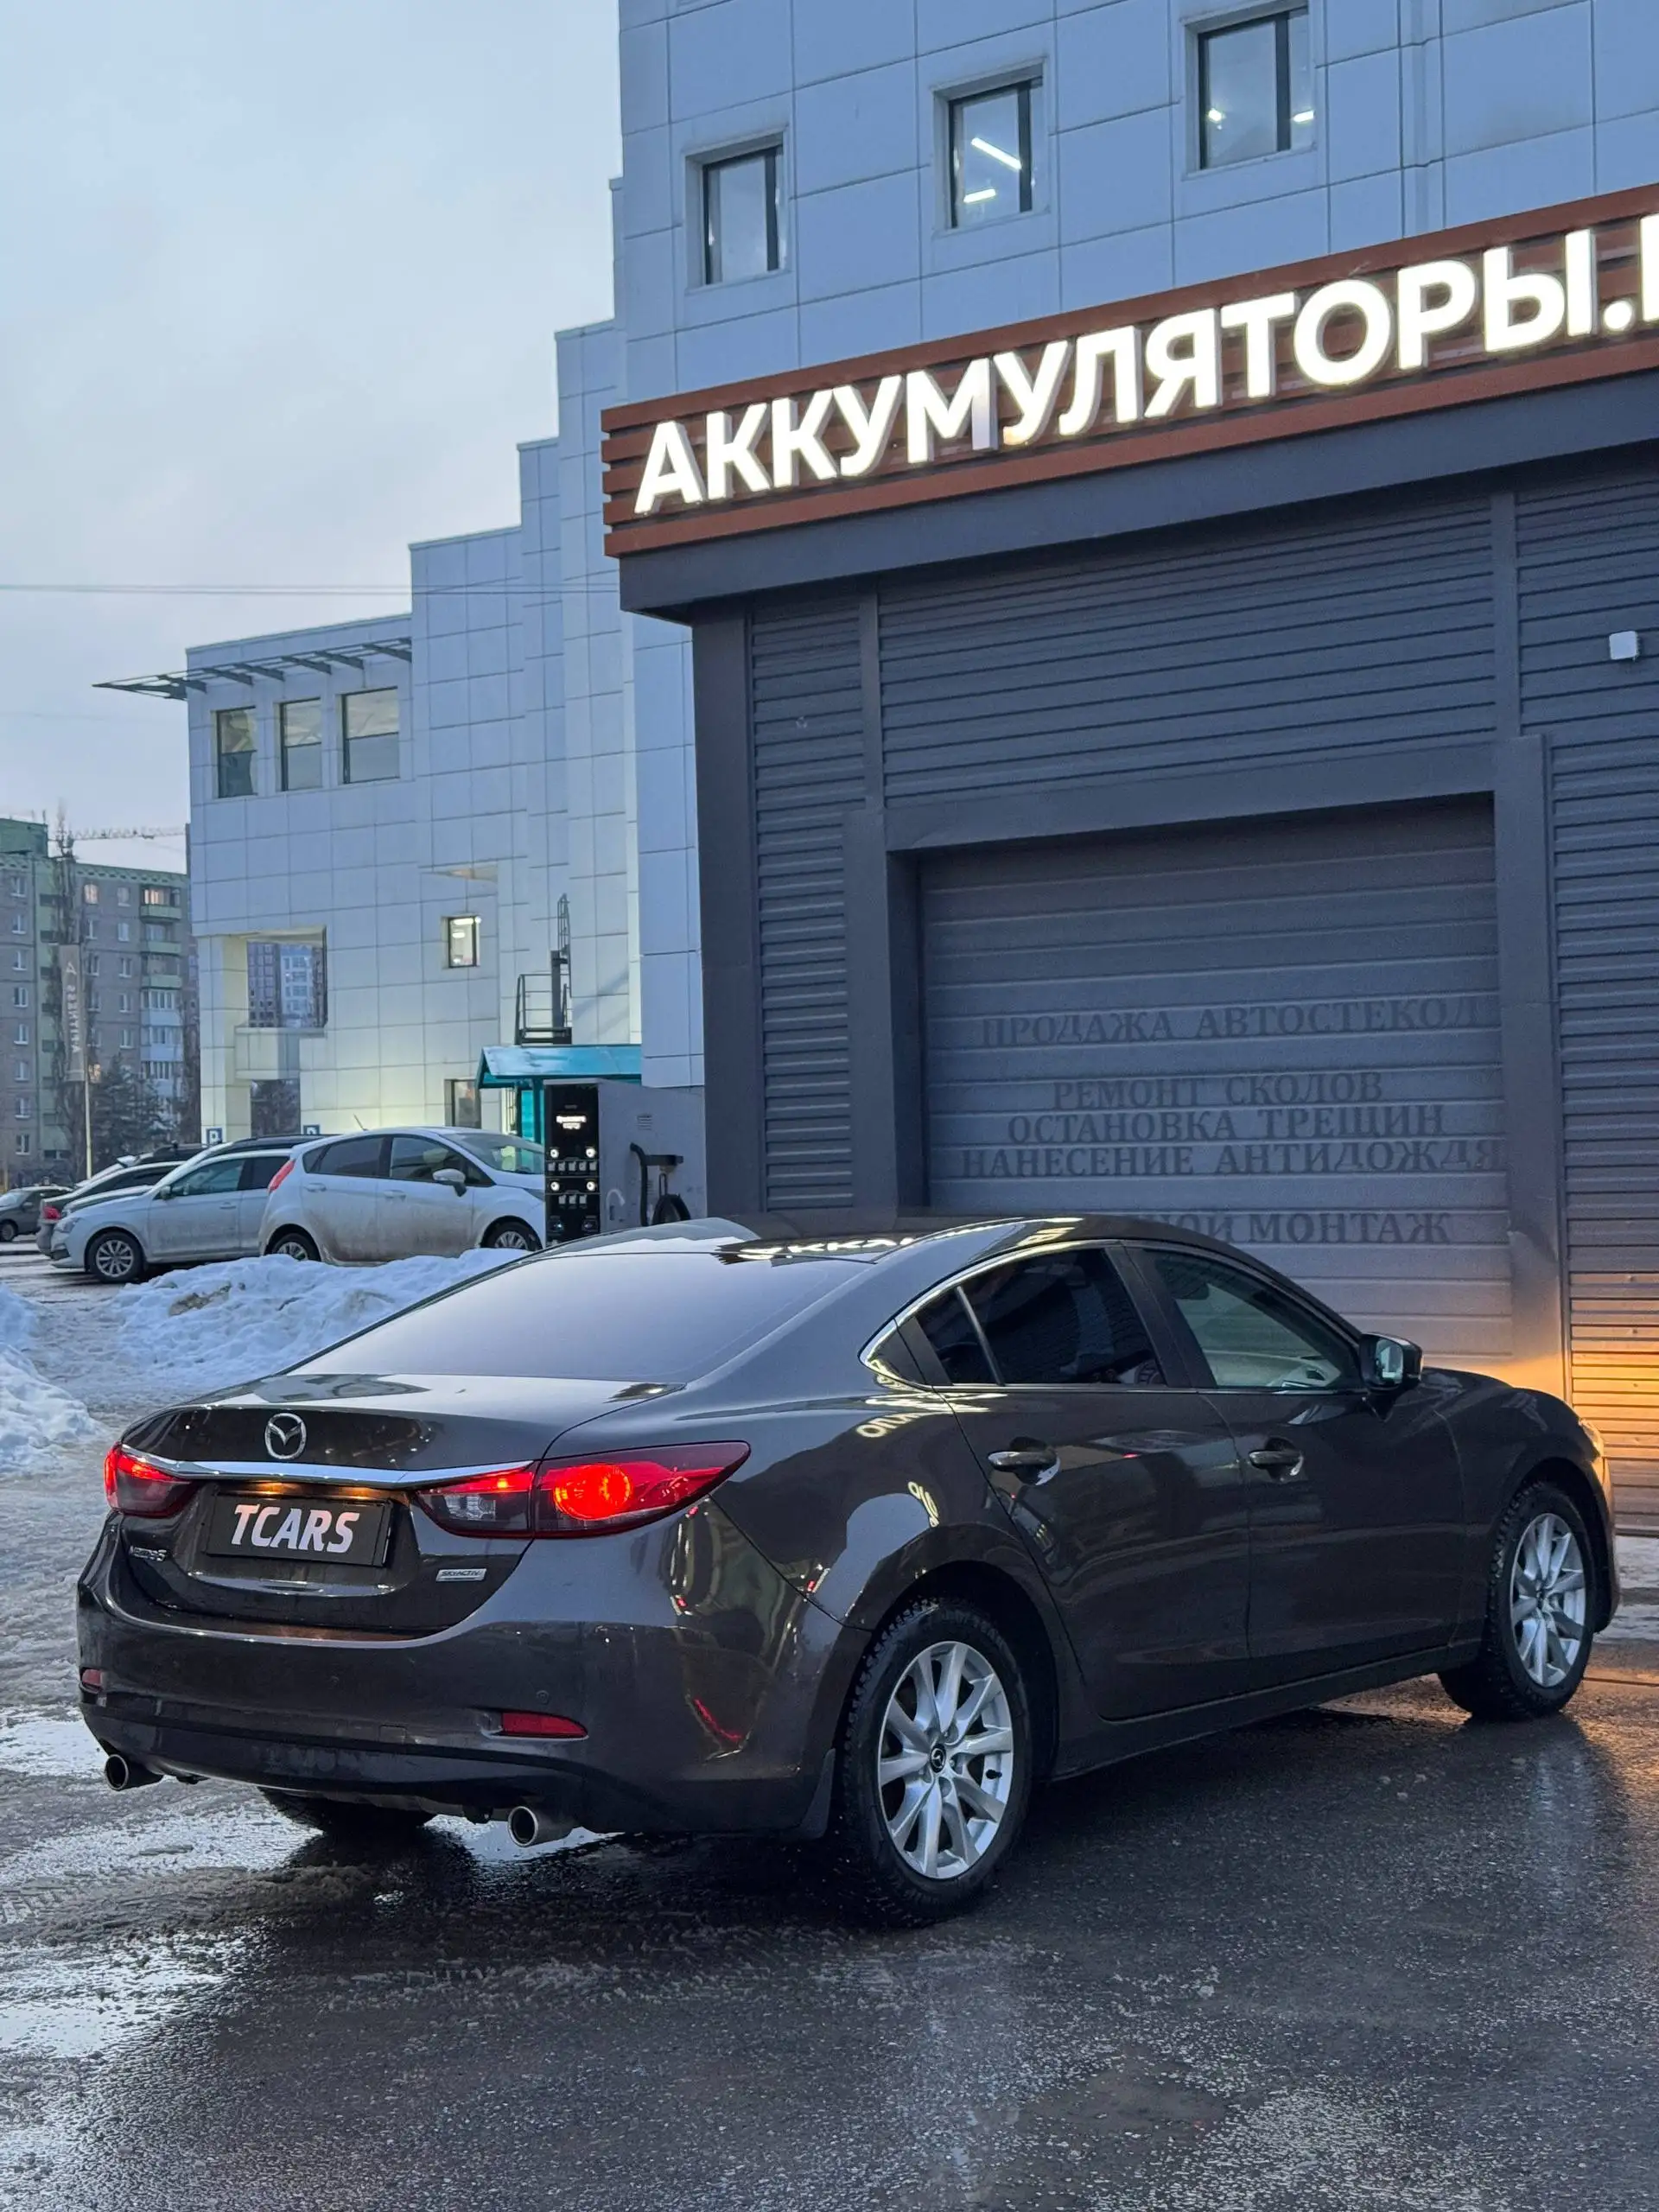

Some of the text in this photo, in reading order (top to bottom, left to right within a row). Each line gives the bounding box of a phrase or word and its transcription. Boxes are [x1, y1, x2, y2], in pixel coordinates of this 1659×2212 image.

[634, 213, 1659, 513] АККУМУЛЯТОРЫ.
[984, 1000, 1478, 1045] ПРОДАЖА АВТОСТЕКОЛ
[1053, 1072, 1384, 1109] РЕМОНТ СКОЛОВ
[1007, 1104, 1446, 1144] ОСТАНОВКА ТРЕЩИН
[961, 1140, 1500, 1178] НАНЕСЕНИЕ АНТИДОЖДЯ
[1248, 1212, 1451, 1244] МОНТАЖ
[232, 1504, 359, 1553] TCARS
